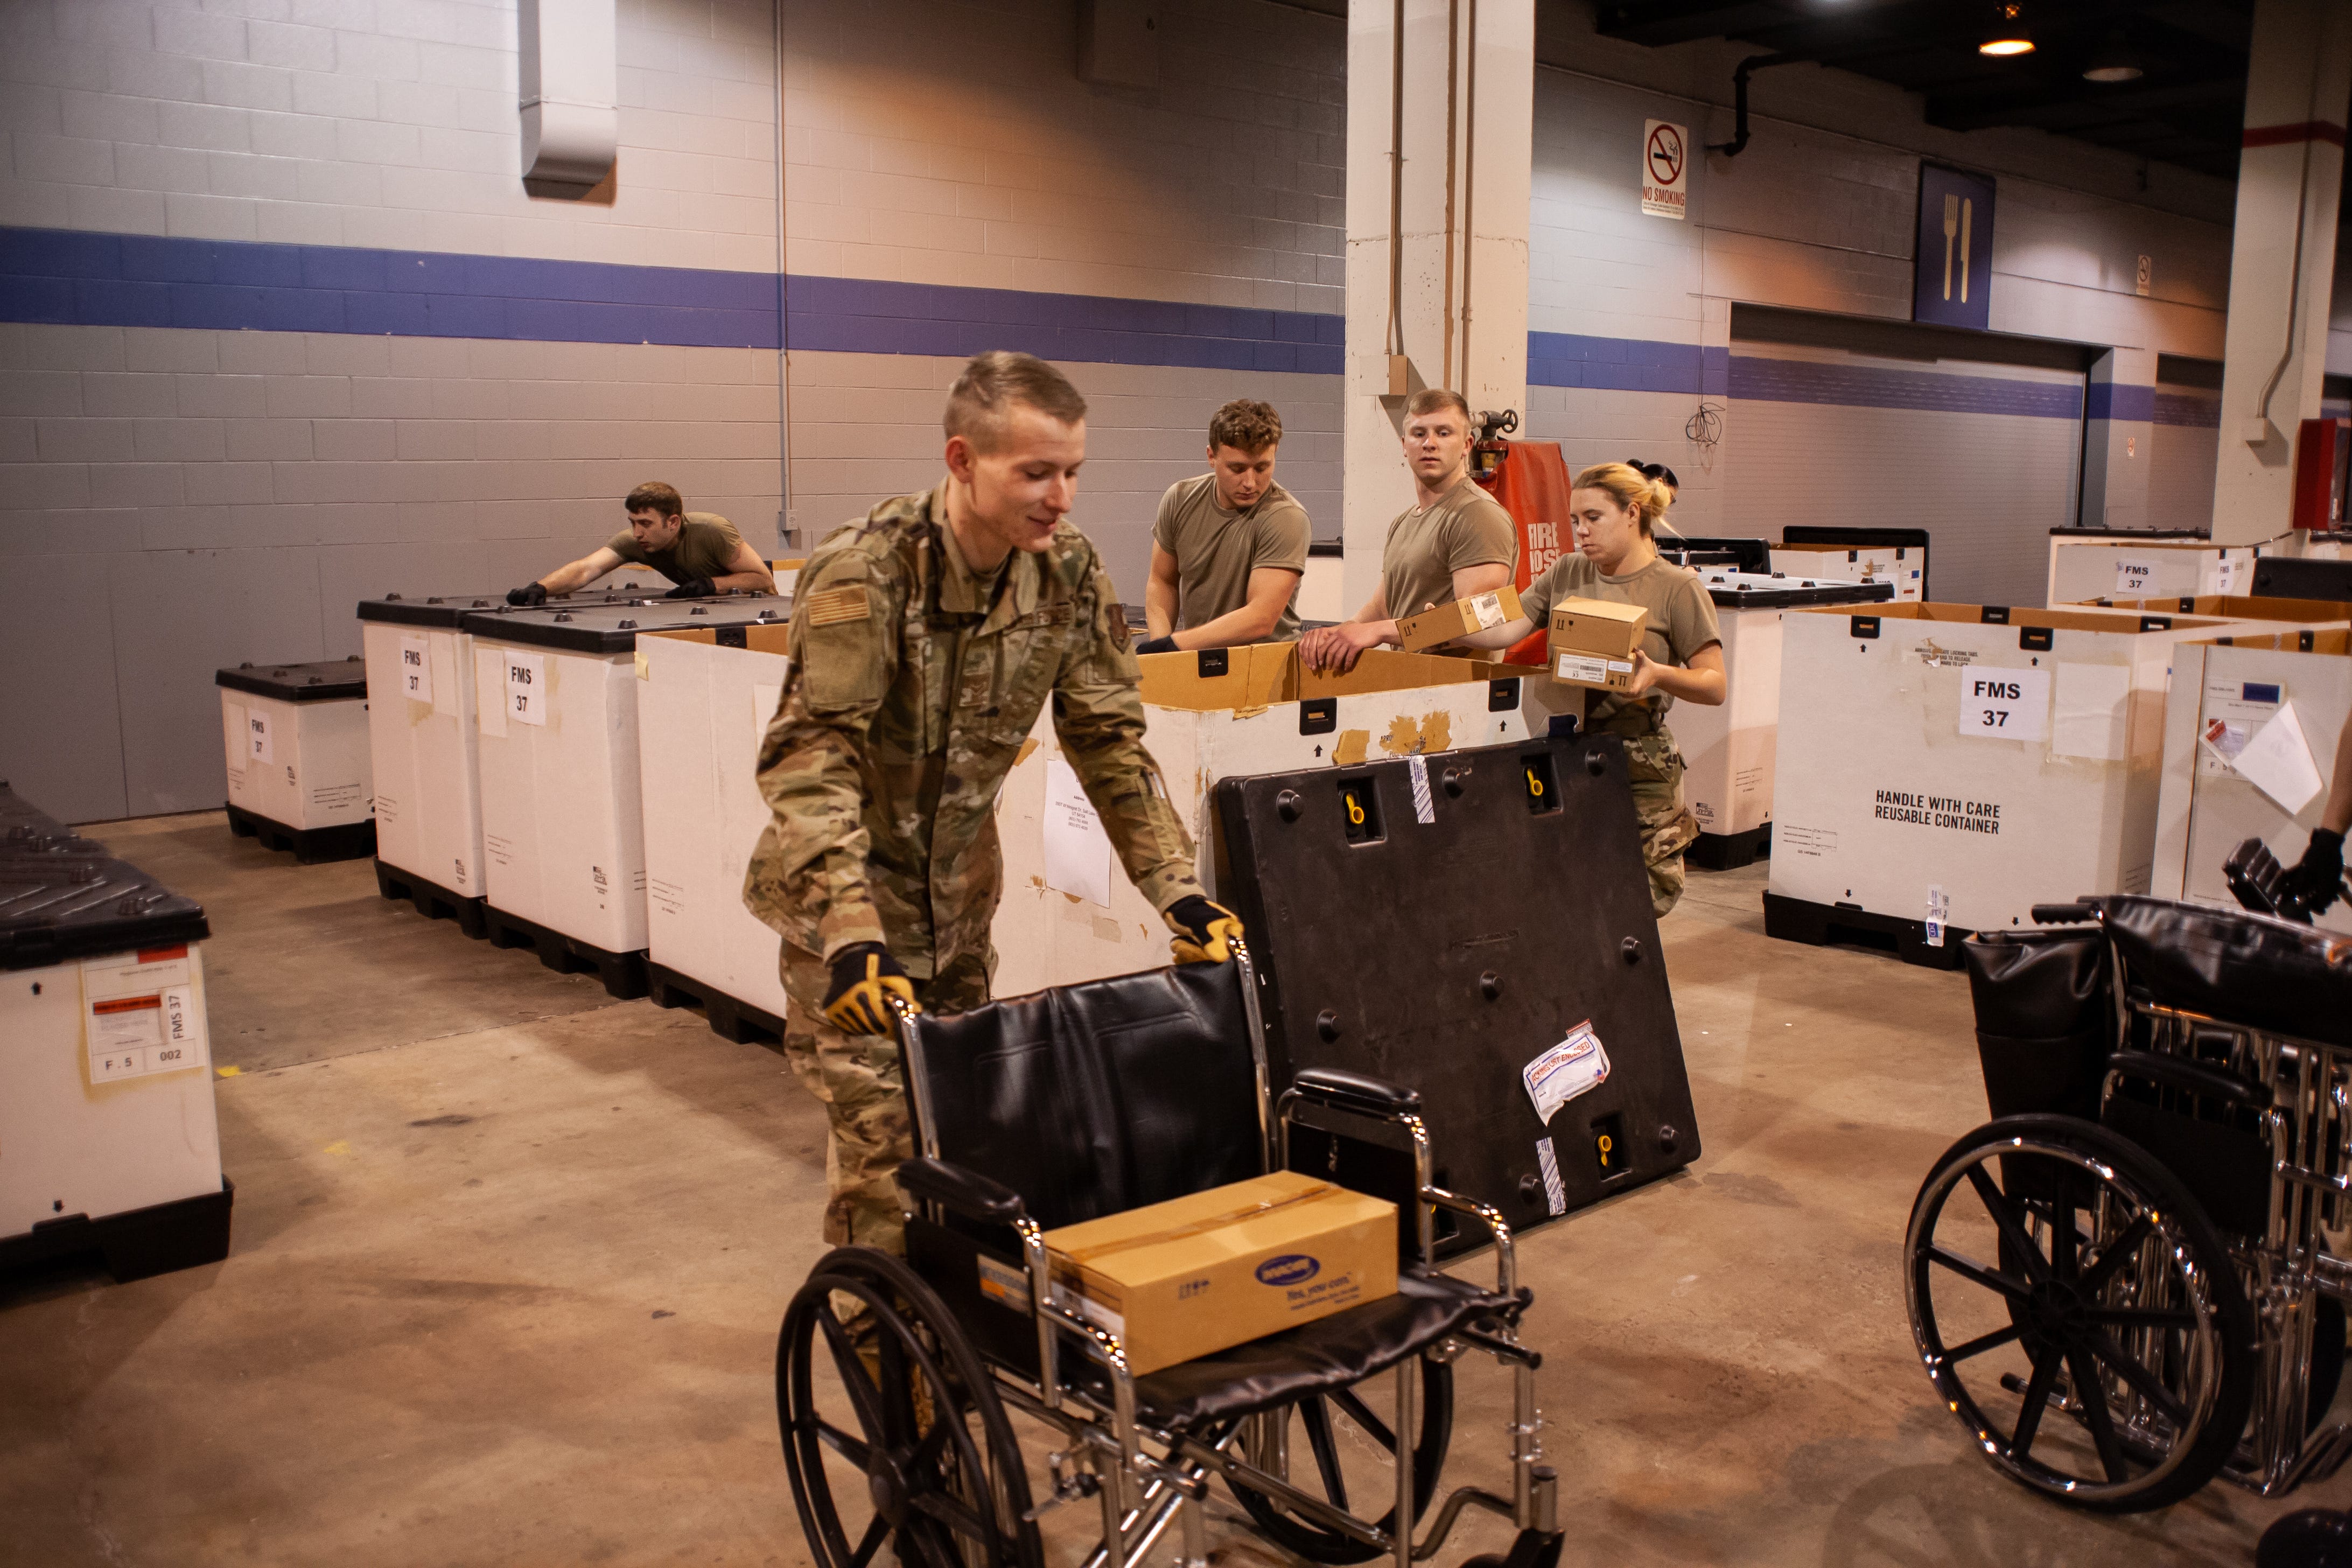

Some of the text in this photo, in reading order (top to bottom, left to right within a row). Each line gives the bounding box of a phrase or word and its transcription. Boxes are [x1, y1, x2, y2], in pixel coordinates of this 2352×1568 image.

[1643, 186, 1685, 207] NO SMOKING
[1528, 522, 1559, 550] FIRE
[2125, 565, 2148, 575] FMS
[2220, 565, 2229, 574] FMS
[2129, 579, 2142, 588] 37
[404, 650, 420, 666] FMS
[410, 676, 418, 690] 37
[511, 666, 531, 684] FMS
[1974, 681, 2020, 699] FMS
[516, 695, 527, 711] 37
[251, 719, 264, 733] FMS
[1983, 710, 2009, 726] 37
[1876, 789, 2000, 818] HANDLE WITH CARE
[1875, 805, 1999, 835] REUSABLE CONTAINER
[168, 995, 184, 1040] FMS 37
[159, 1049, 181, 1061] 002
[105, 1060, 113, 1070] F
[124, 1058, 132, 1067] 5
[1531, 1063, 1551, 1084] ACKING
